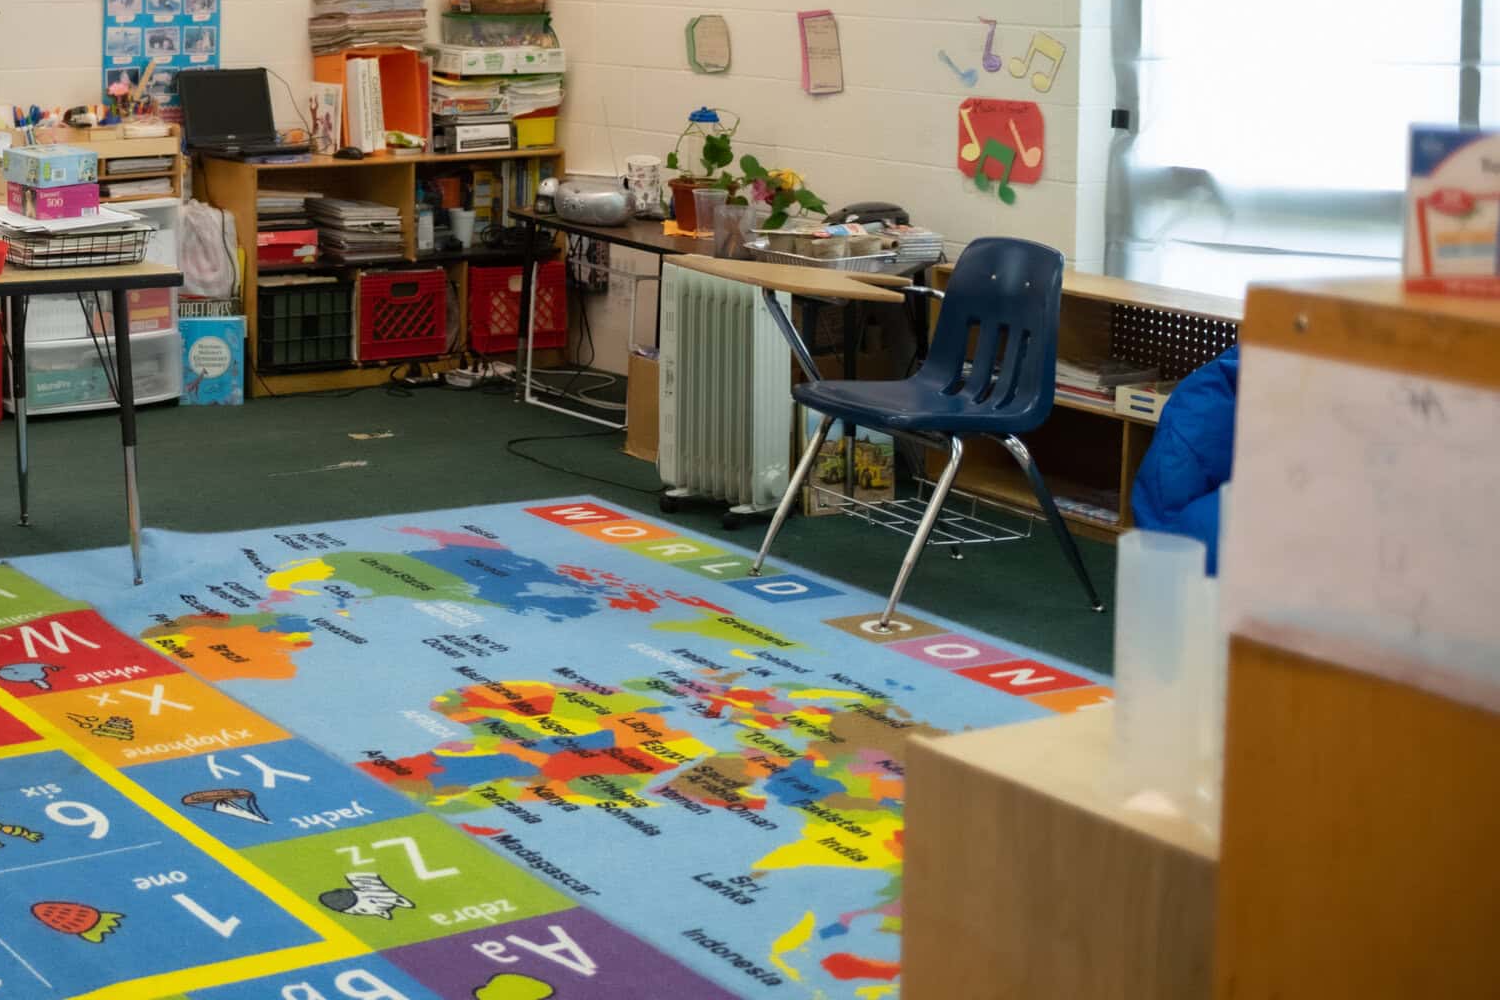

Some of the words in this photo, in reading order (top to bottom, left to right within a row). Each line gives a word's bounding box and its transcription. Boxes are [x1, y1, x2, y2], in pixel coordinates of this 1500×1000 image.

[311, 617, 369, 644] Venezuela
[465, 633, 510, 653] North
[717, 615, 796, 647] Greenland
[208, 644, 250, 664] Brazil
[421, 637, 467, 659] Ocean
[437, 634, 492, 658] Atlantic
[75, 664, 147, 684] whale
[753, 651, 814, 674] Iceland
[451, 665, 523, 701] Mauritania
[552, 666, 615, 696] Morocco
[658, 670, 711, 693] France
[827, 672, 891, 699] Norway
[558, 690, 613, 716] Algeria
[845, 703, 916, 729] Finland
[484, 720, 539, 748] Nigeria
[533, 716, 578, 736] Niger
[618, 717, 663, 739] Libya
[782, 715, 846, 743] Ukraine
[122, 728, 253, 760] xylophone
[639, 740, 694, 763] Egypt
[746, 731, 800, 758] Turkey
[363, 750, 413, 776] Angola
[602, 747, 654, 772] Sudan
[692, 765, 750, 788] Saudi
[779, 776, 820, 795] Iran
[21, 783, 62, 799] six
[527, 785, 580, 813] Kenya
[580, 774, 649, 809] Ethiopia
[655, 785, 712, 815] Yemen
[290, 800, 373, 830] yacht
[473, 786, 544, 824] Tanzania
[726, 803, 779, 831] Oman
[44, 800, 110, 840] 6
[596, 800, 662, 838] Somalia
[794, 799, 872, 840] Pakistan
[491, 830, 601, 897] Madagascar
[816, 836, 870, 864] India
[133, 869, 188, 891] one
[692, 871, 756, 906] Lanka
[728, 874, 770, 893] Sri
[173, 893, 242, 938] 1
[430, 899, 517, 925] zebra
[680, 927, 784, 988] Indonesia
